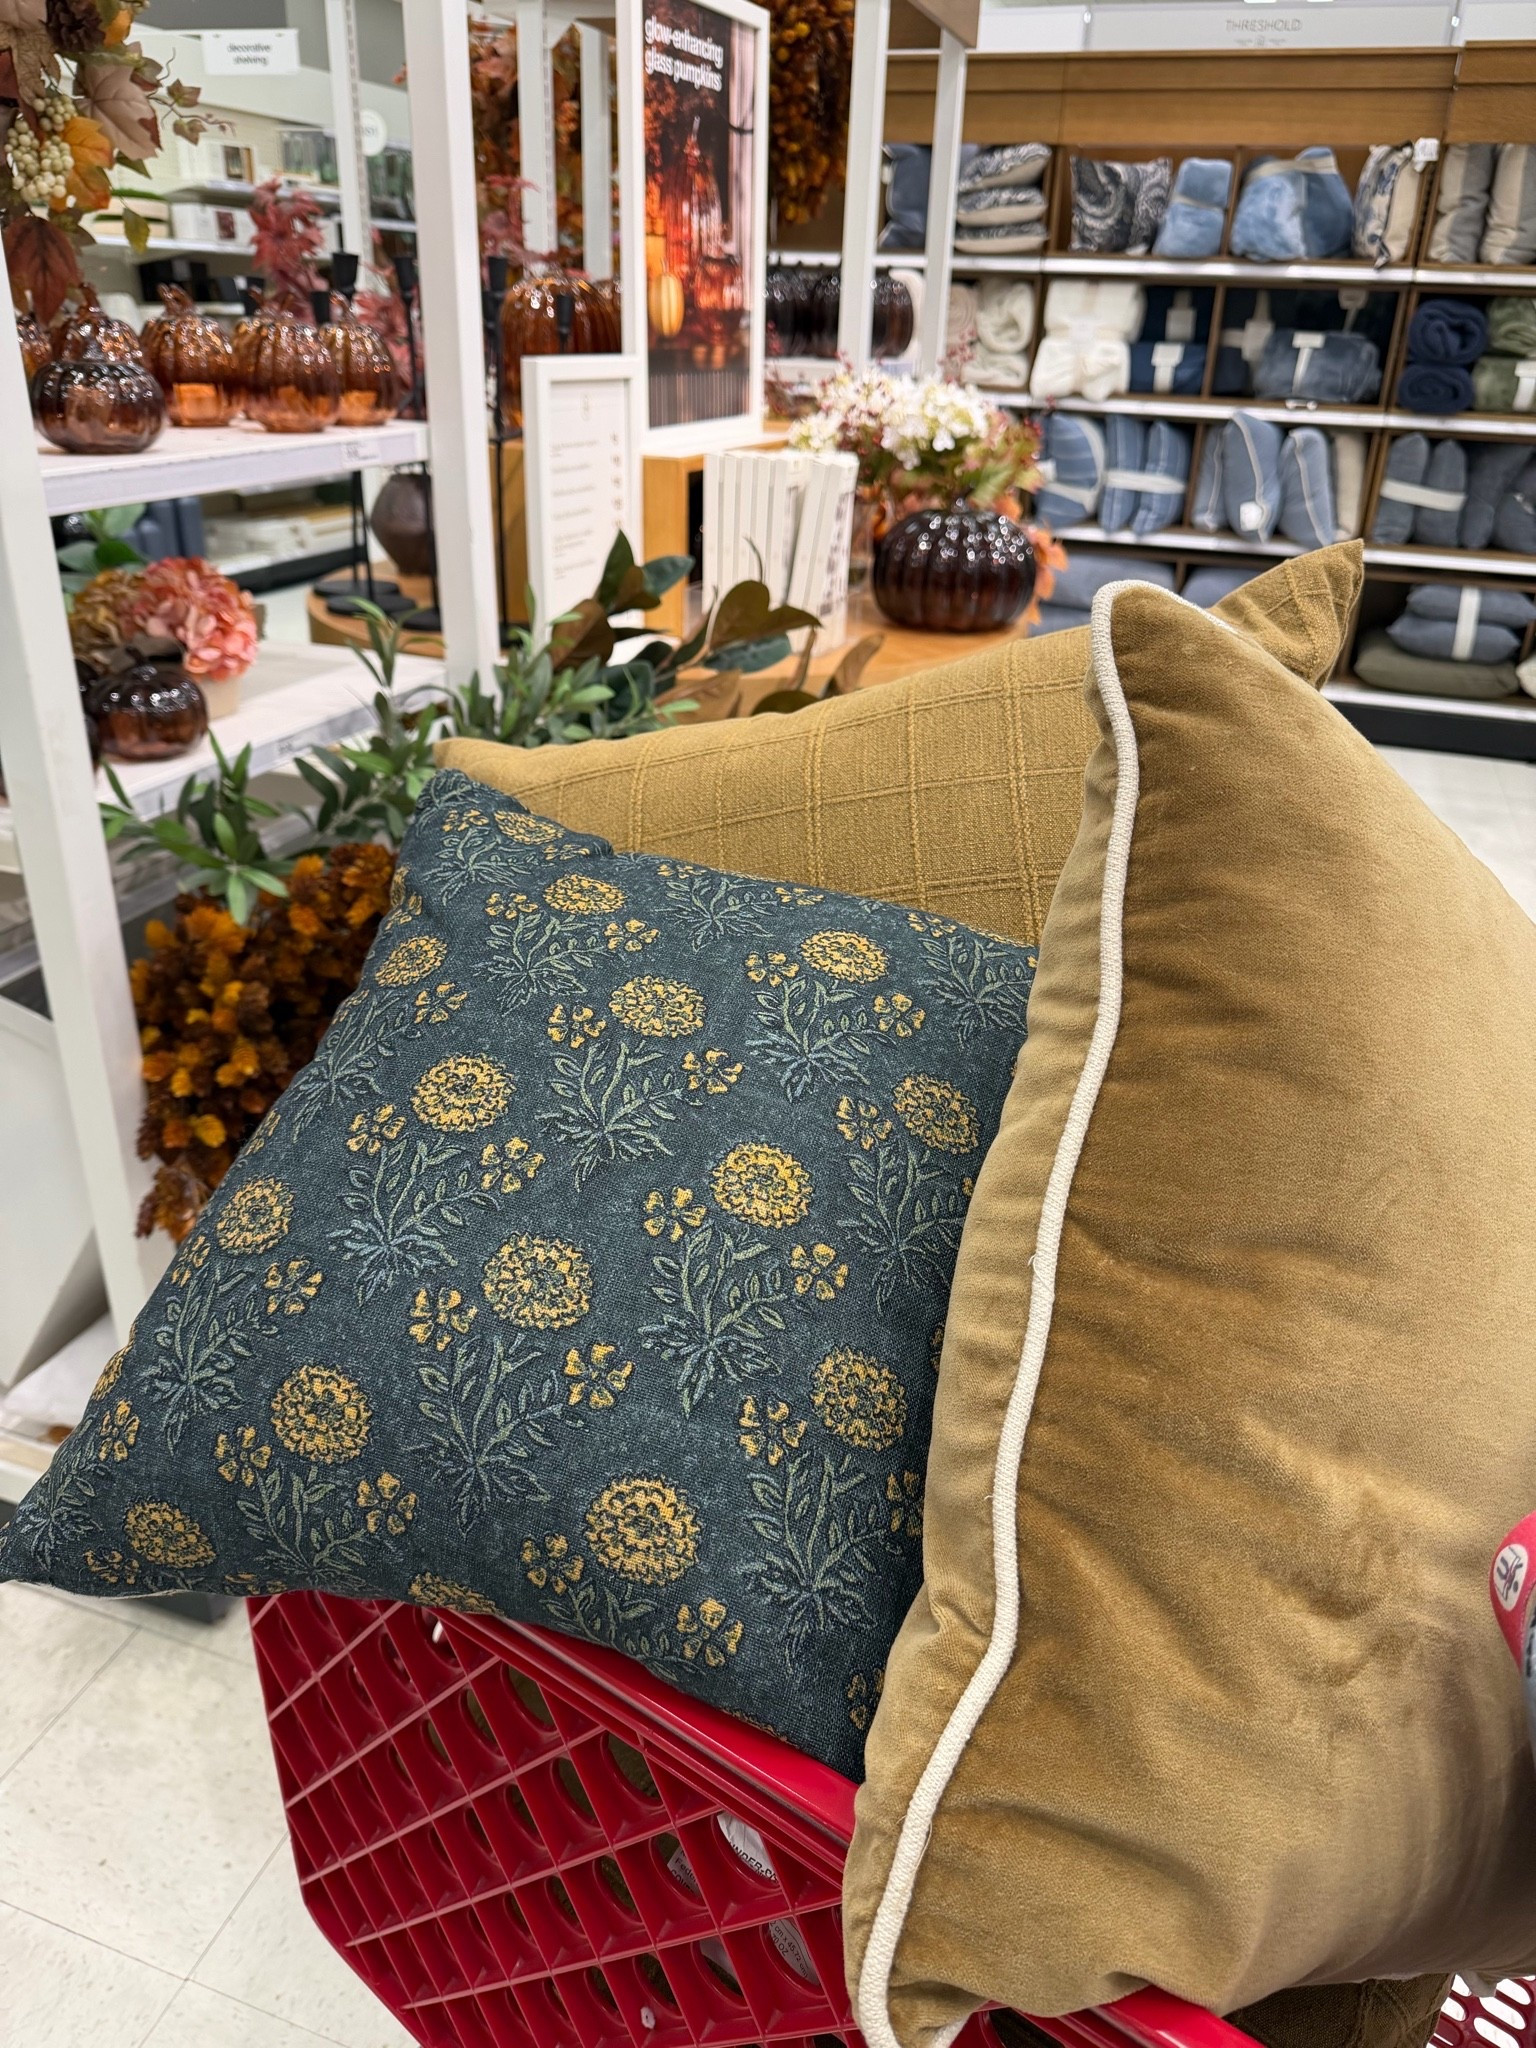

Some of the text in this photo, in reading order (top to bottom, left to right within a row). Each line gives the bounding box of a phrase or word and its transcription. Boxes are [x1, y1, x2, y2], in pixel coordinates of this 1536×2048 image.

[1226, 18, 1302, 32] THRESHOLD
[227, 42, 271, 53] decorative
[645, 15, 724, 69] glow-enhancing
[645, 45, 723, 92] glass pumpkins
[779, 1943, 788, 1956] OZ
